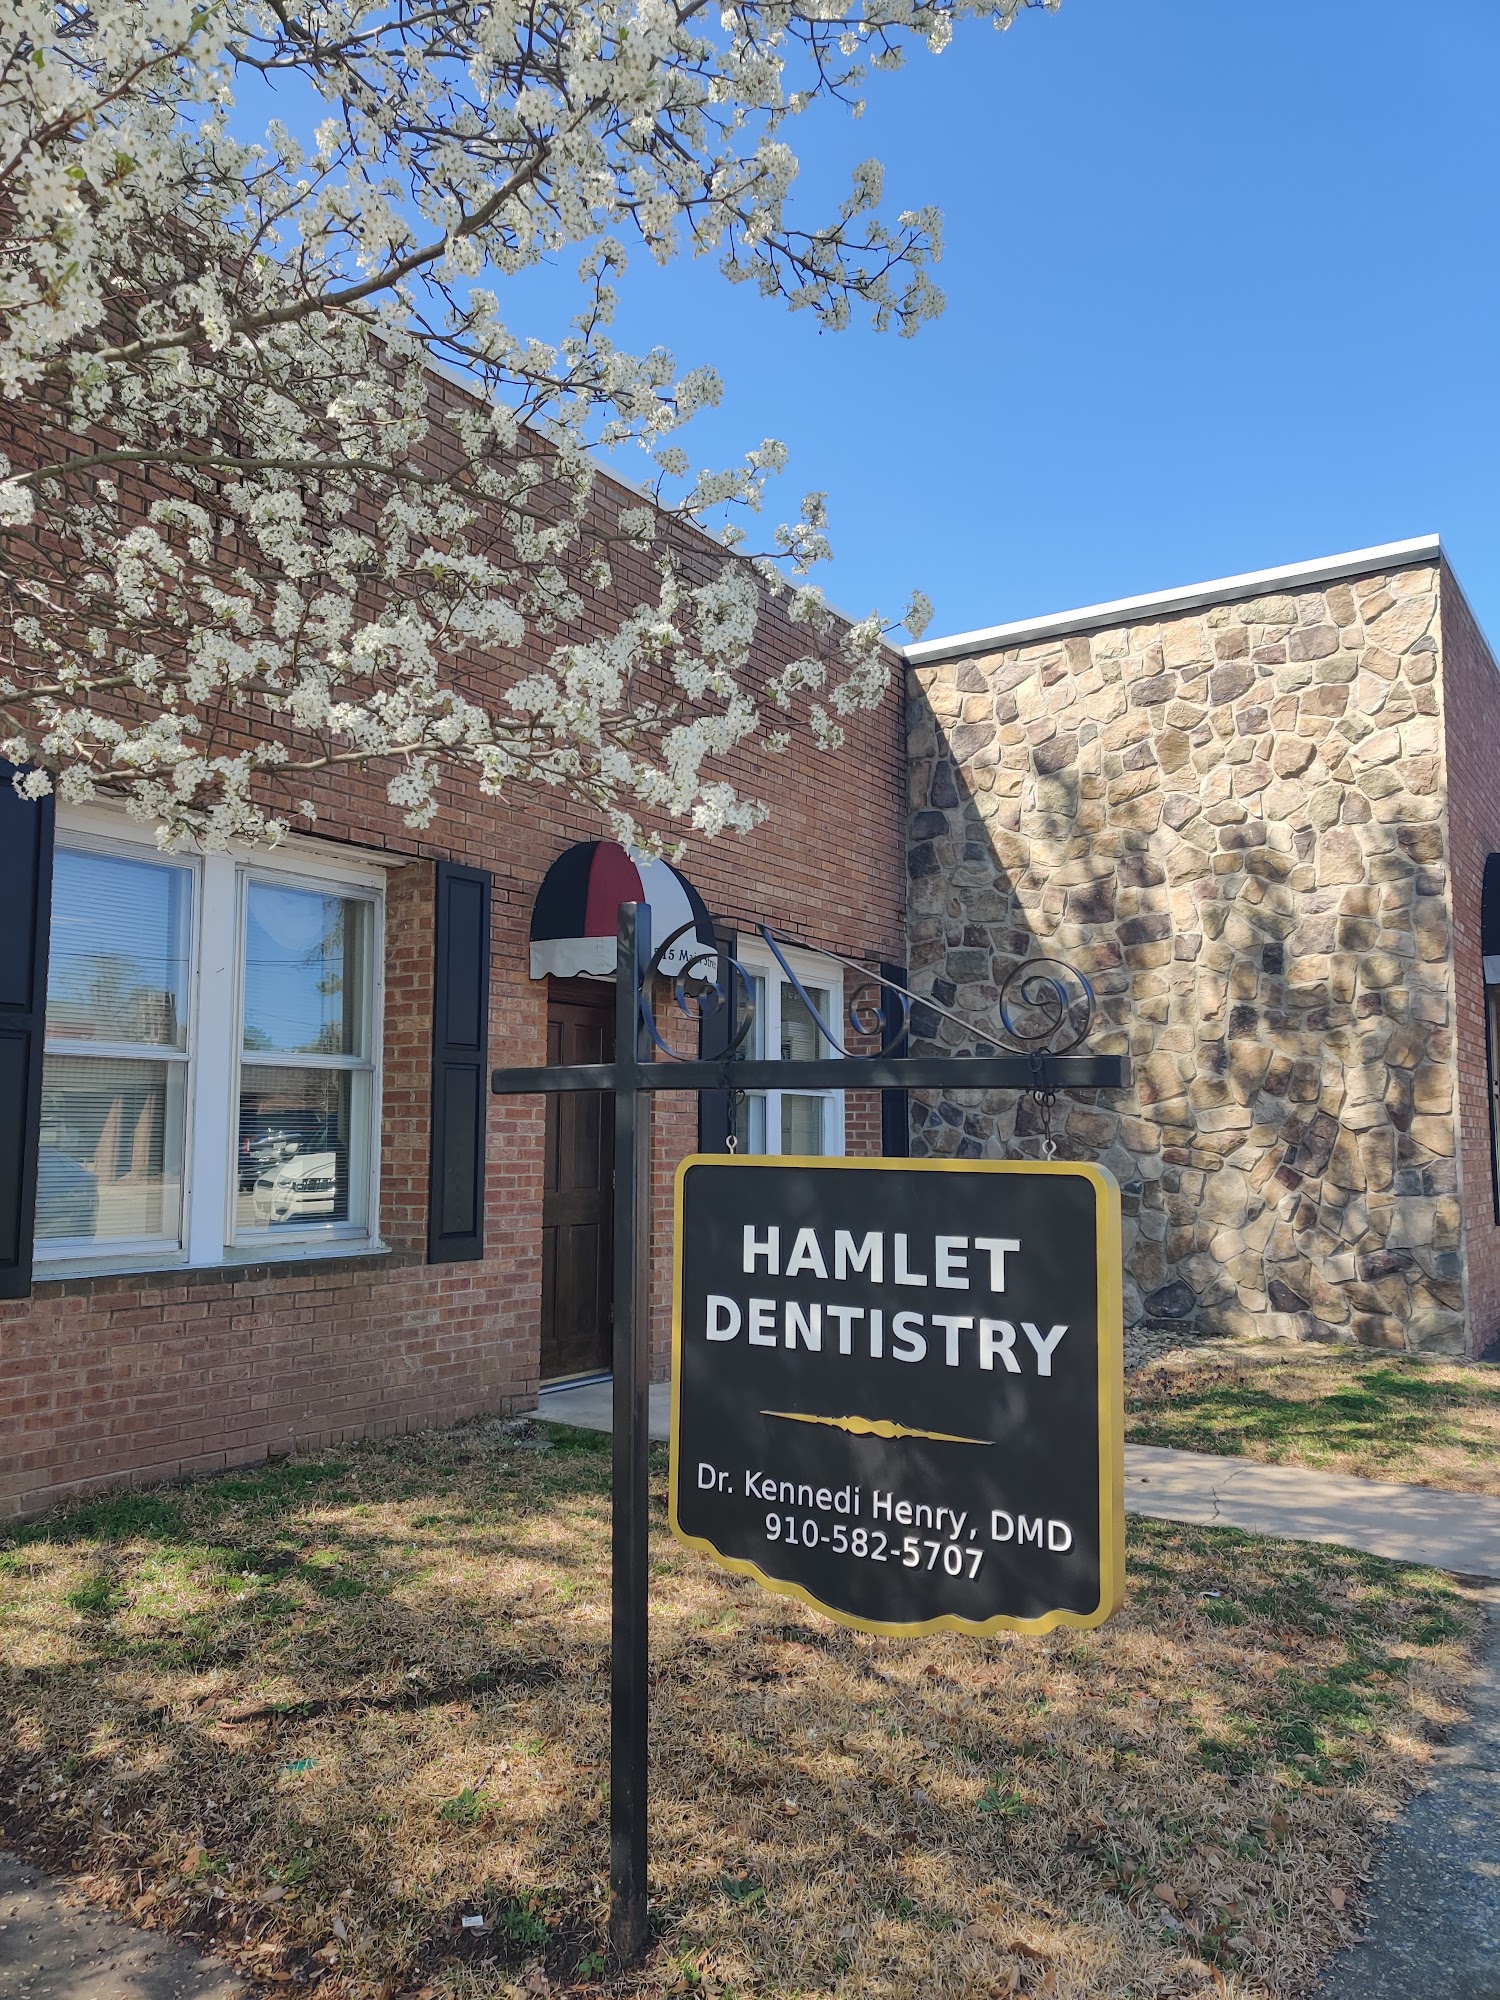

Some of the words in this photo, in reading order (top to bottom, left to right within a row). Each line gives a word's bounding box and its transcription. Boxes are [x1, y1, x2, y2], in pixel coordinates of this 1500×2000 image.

[742, 1224, 1022, 1294] HAMLET
[705, 1294, 1070, 1378] DENTISTRY
[696, 1462, 734, 1495] Dr.
[745, 1469, 861, 1517] Kennedi
[872, 1488, 980, 1542] Henry,
[990, 1509, 1074, 1554] DMD
[764, 1511, 985, 1580] 910-582-5707
